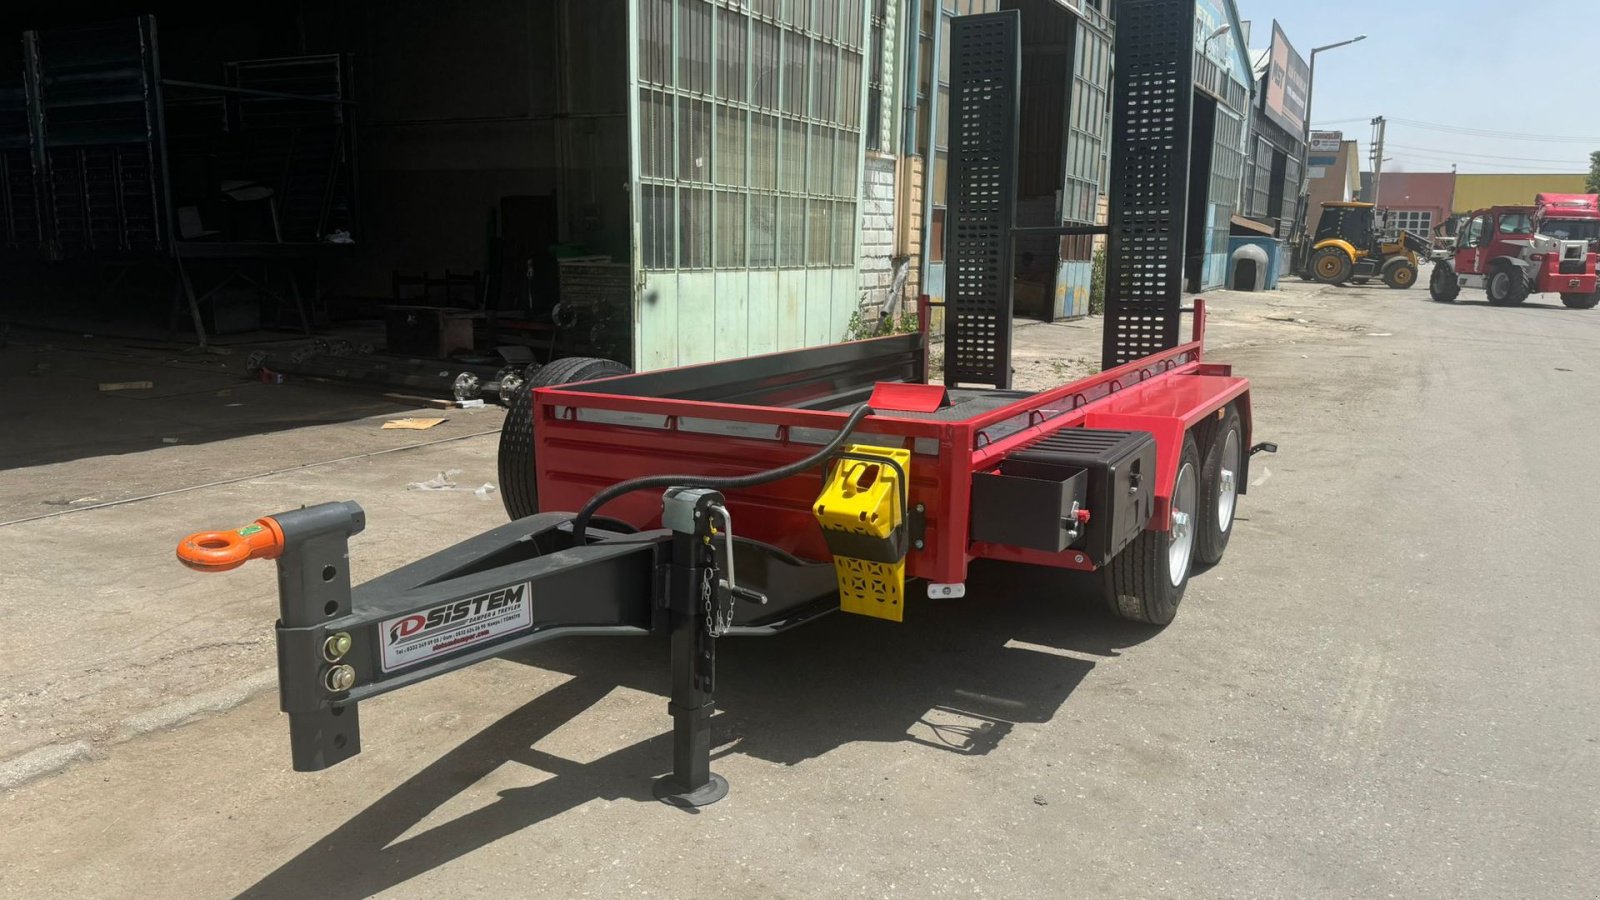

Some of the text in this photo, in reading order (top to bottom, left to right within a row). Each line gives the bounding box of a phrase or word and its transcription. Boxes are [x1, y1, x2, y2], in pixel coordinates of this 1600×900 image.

[468, 613, 491, 623] DAMPER
[497, 603, 521, 614] TREYLER
[486, 619, 500, 627] Konya
